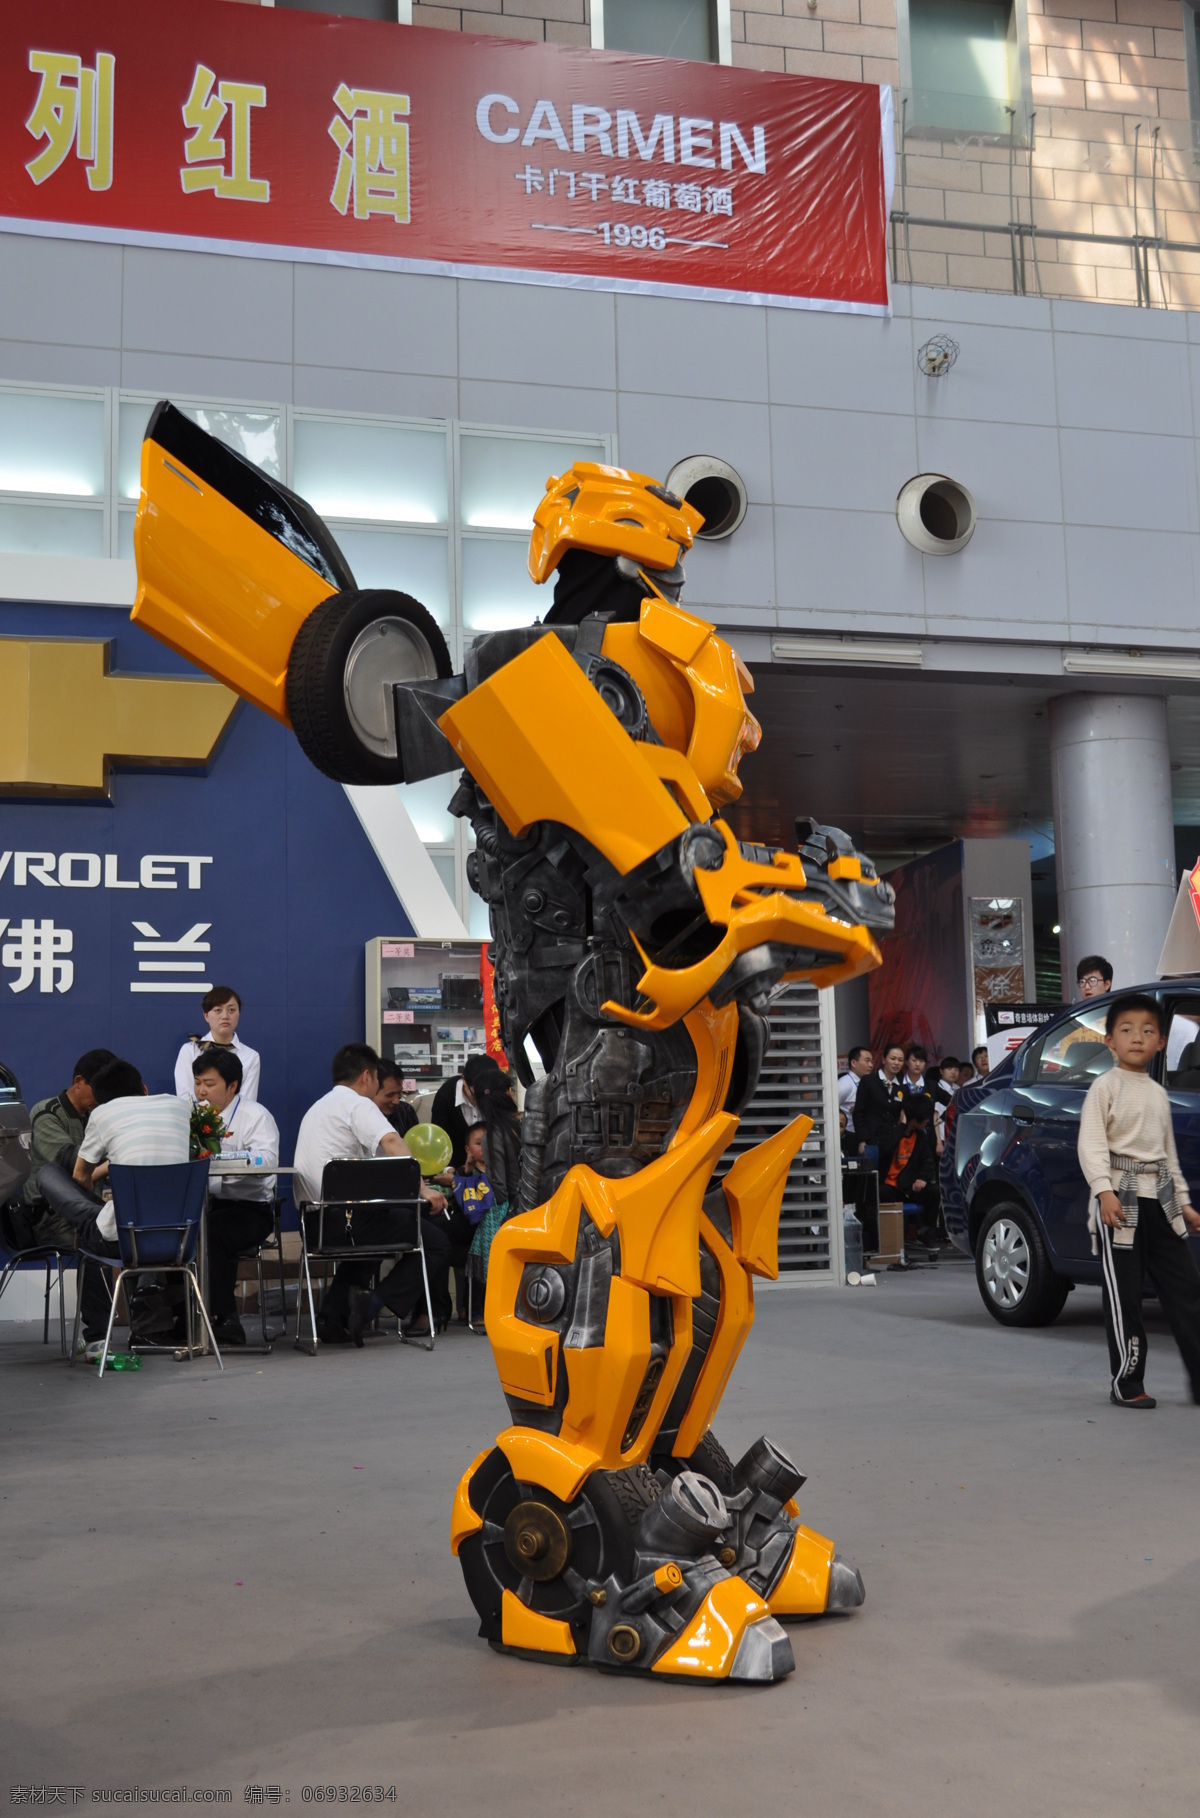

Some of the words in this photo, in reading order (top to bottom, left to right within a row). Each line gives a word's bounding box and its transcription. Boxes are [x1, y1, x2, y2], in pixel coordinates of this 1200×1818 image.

[475, 93, 767, 175] CARMEN
[515, 164, 734, 216] 卡门干红葡萄酒
[598, 221, 667, 251] 1996
